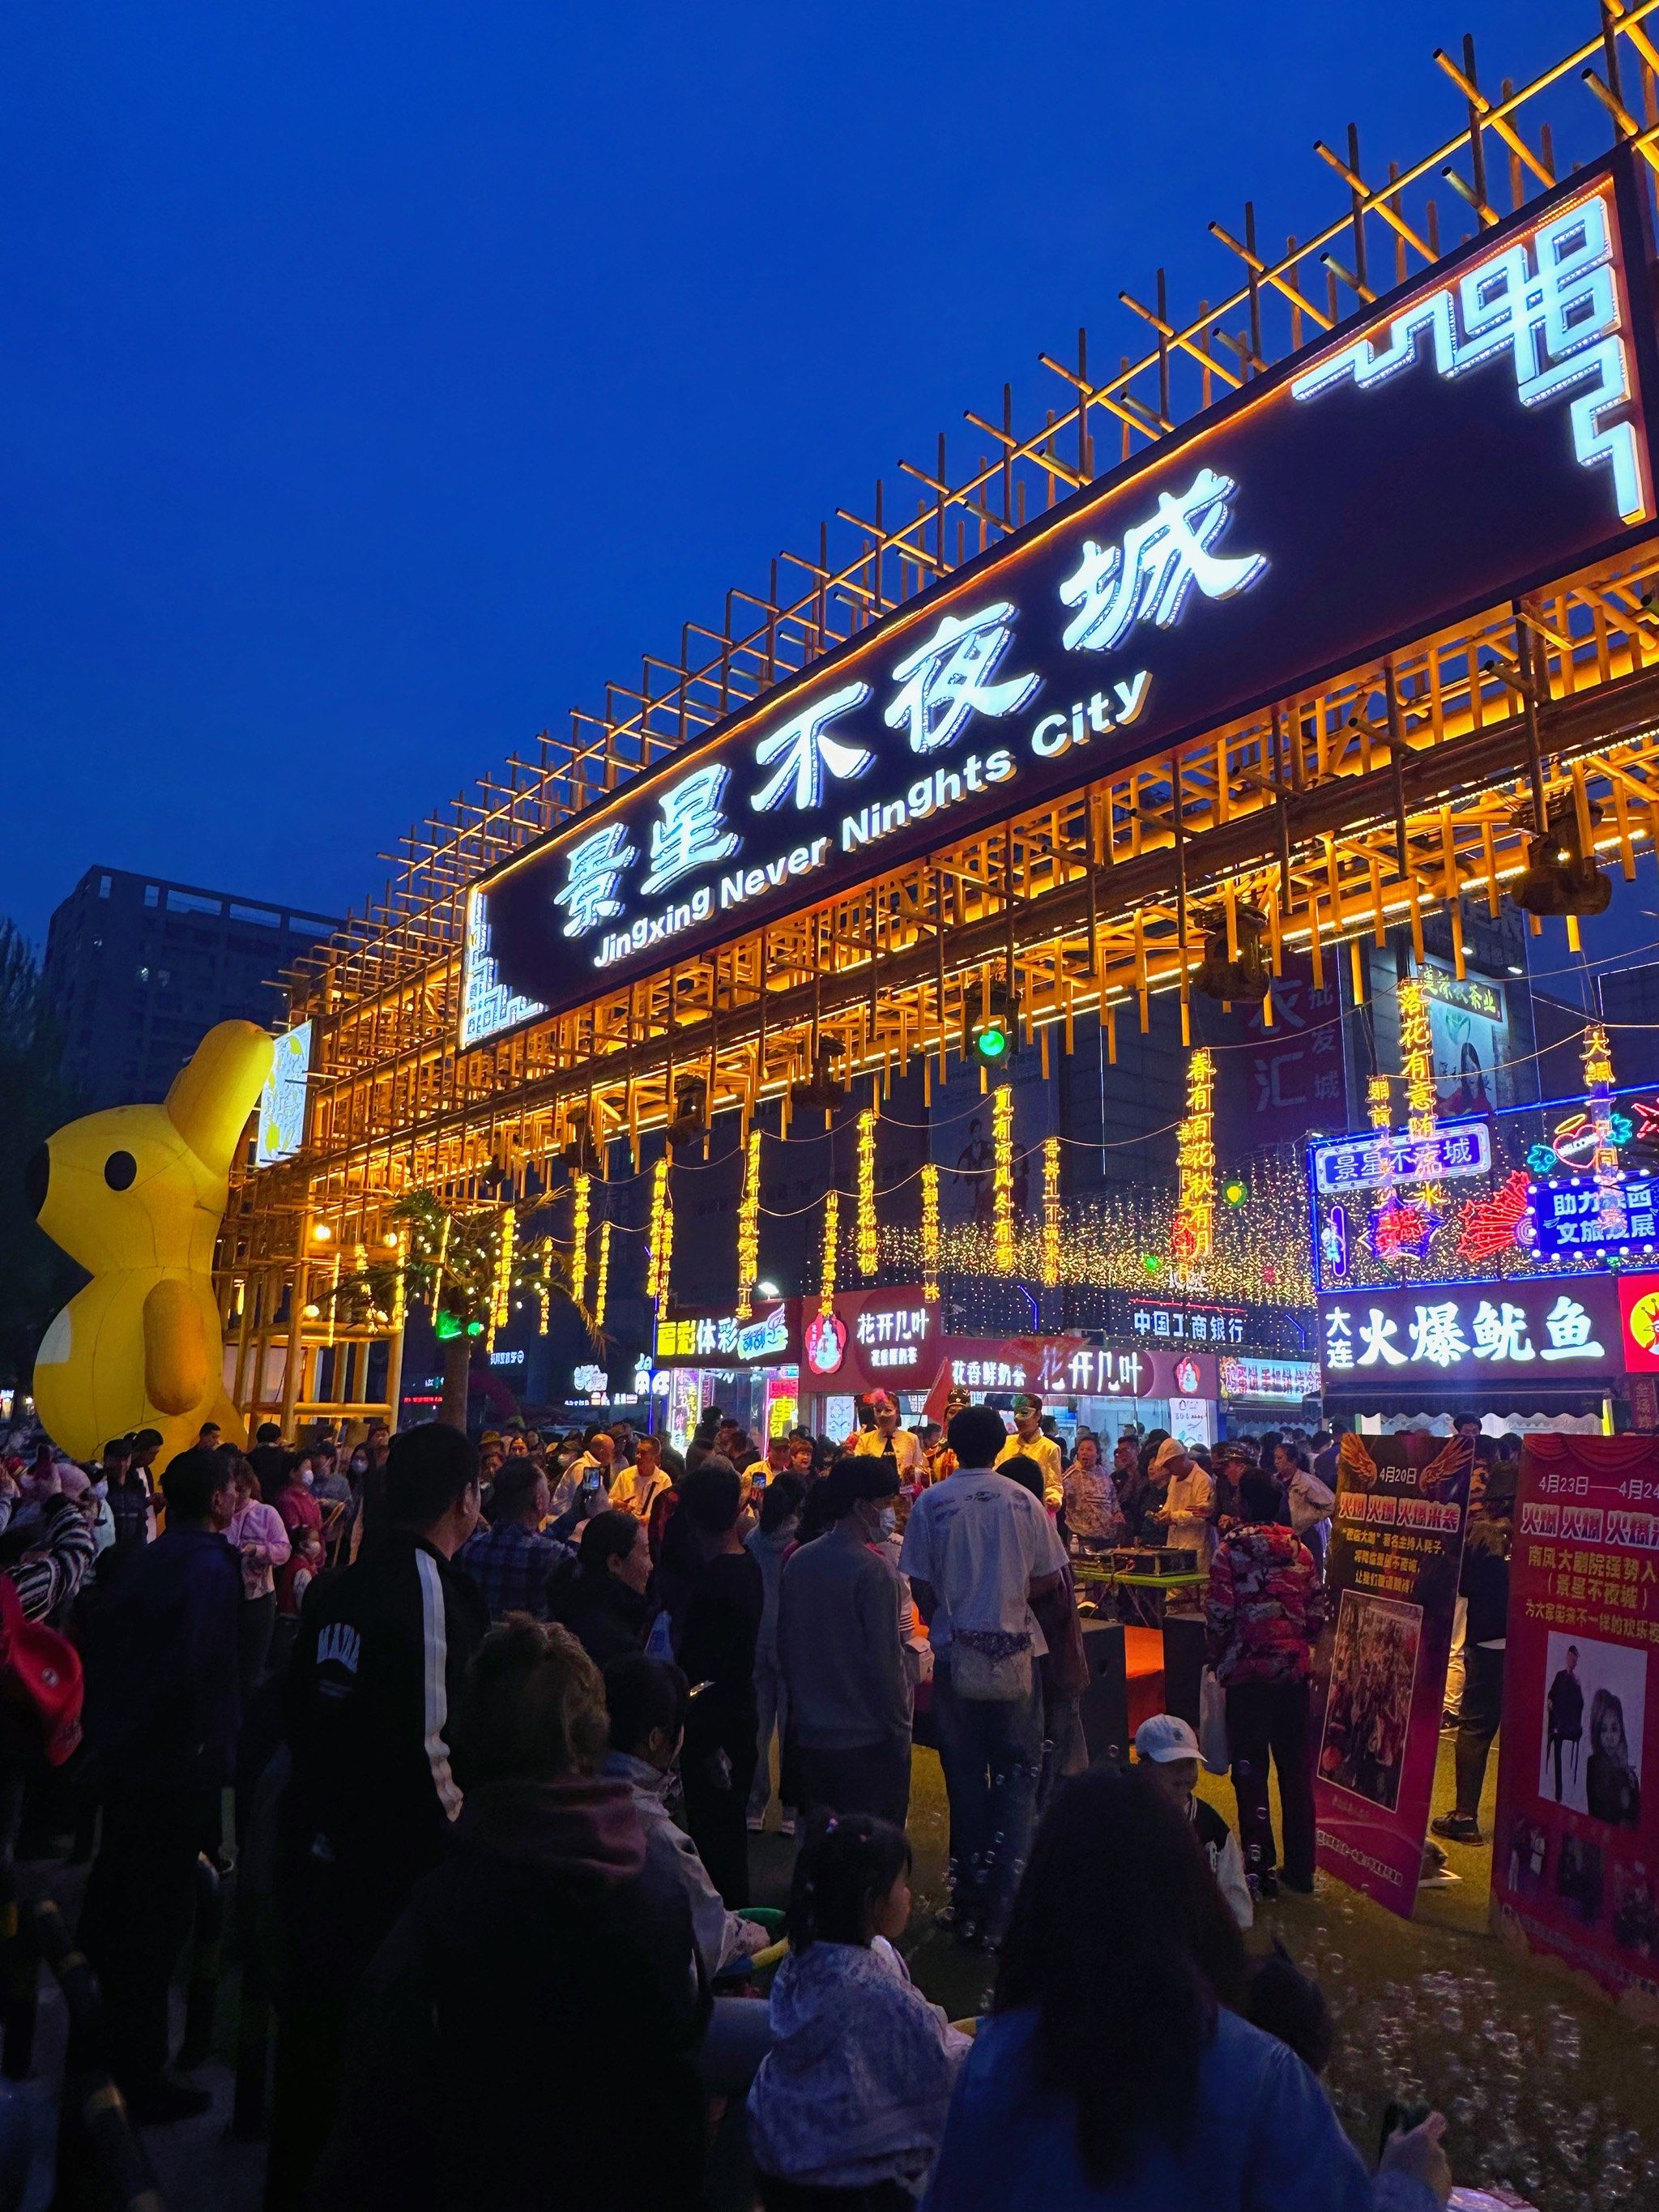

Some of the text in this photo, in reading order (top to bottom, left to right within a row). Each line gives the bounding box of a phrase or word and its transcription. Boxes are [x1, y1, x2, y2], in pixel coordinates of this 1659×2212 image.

[554, 467, 1271, 938] 景星不夜城
[594, 670, 1152, 967] Jingxing Never Ninghts City
[992, 1087, 1014, 1270] 夏有凉风冬有雪
[1187, 1053, 1218, 1260] 春有百花秋有月
[856, 1111, 876, 1275] 年年岁岁花相似
[856, 1308, 930, 1344] 花开几叶
[1134, 1309, 1243, 1343] 中国工商银行
[1325, 1306, 1355, 1369] 大连
[1356, 1296, 1605, 1367] 火爆鱿鱼
[952, 1360, 1026, 1387] 花香鲜奶茶
[1038, 1346, 1143, 1394] 花开几叶
[1379, 1467, 1418, 1484] 4月20日
[1339, 1492, 1461, 1533] 火爆 火爆 火爆来袭
[1520, 1502, 1560, 1537] 火爆
[1560, 1505, 1604, 1543] 火爆
